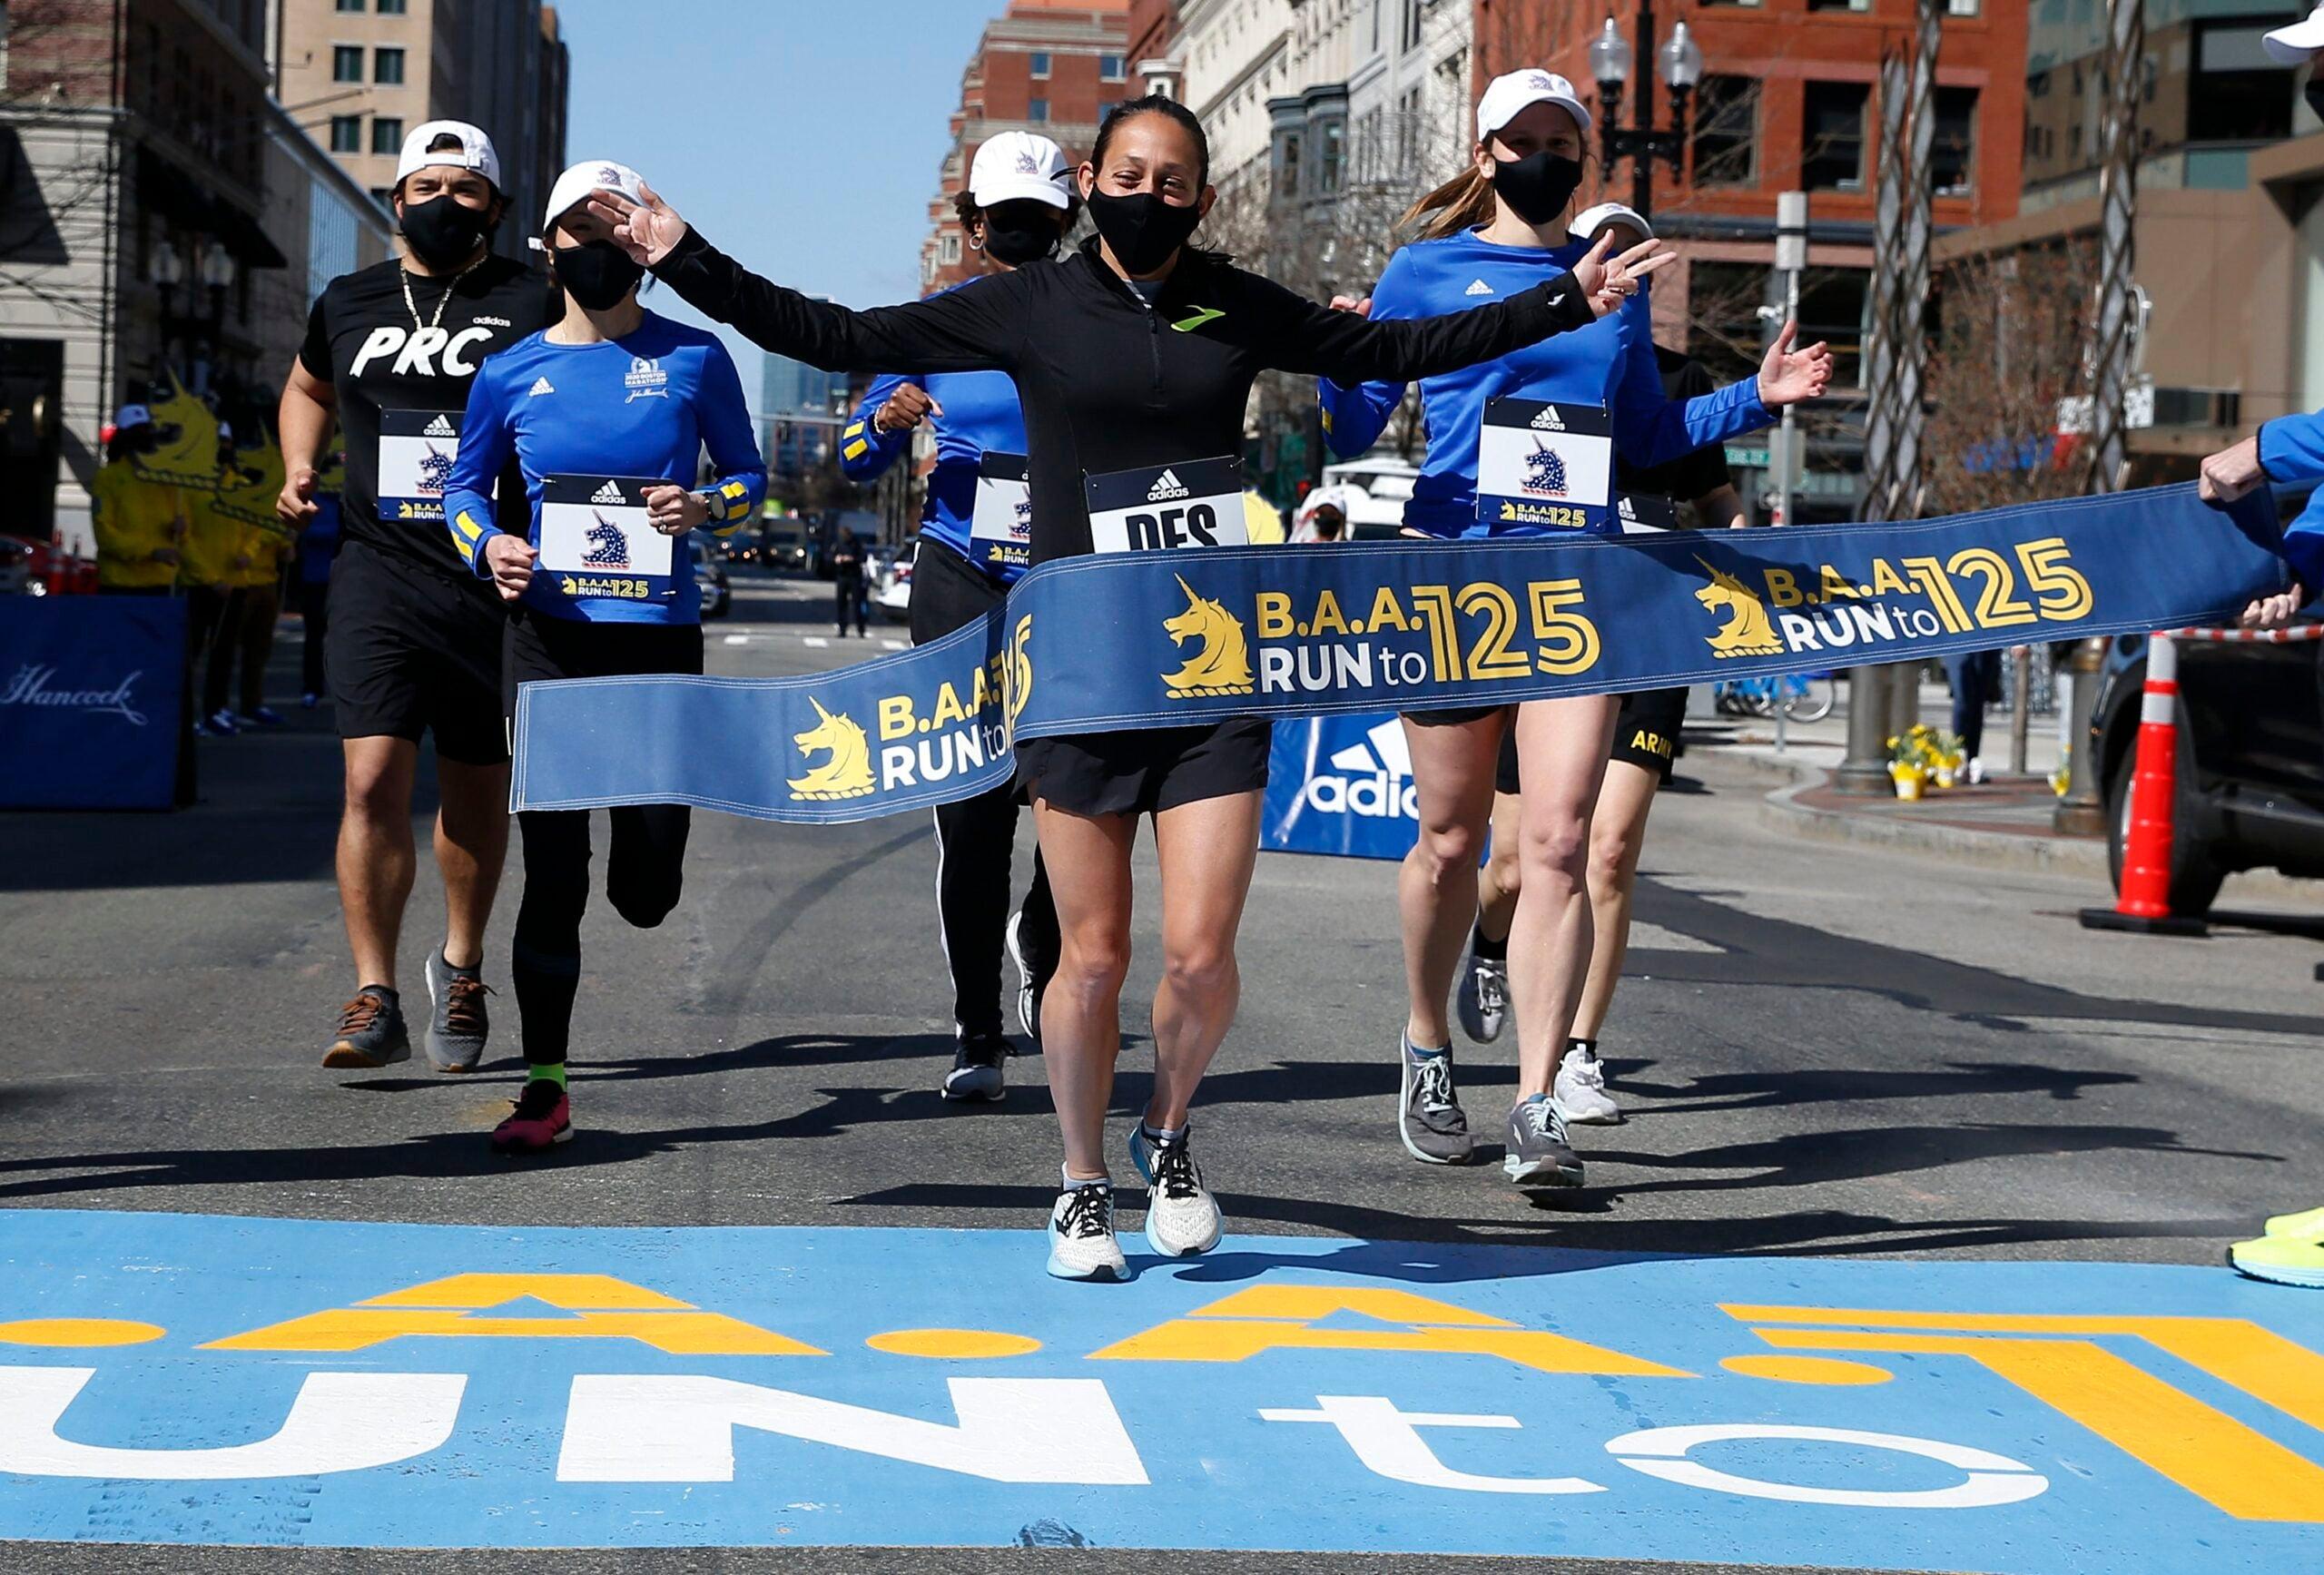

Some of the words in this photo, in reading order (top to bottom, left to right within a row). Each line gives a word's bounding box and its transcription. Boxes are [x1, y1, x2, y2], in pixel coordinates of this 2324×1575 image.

[473, 317, 511, 327] adidas
[349, 327, 494, 378] PRC
[423, 427, 456, 436] adidas
[1530, 418, 1565, 431] adidas
[414, 503, 443, 511] B.A.A
[590, 495, 626, 505] adidas
[1147, 486, 1189, 502] adidas
[414, 511, 435, 519] RUN
[1516, 513, 1540, 524] RUN
[1548, 507, 1586, 527] 125
[1517, 503, 1551, 516] B.A.A.
[1003, 555, 1025, 565] RUN
[578, 577, 612, 587] B.A.A.
[578, 586, 601, 596] RUN
[610, 579, 649, 598] 125
[1762, 557, 1923, 608] B.A.A.
[1900, 536, 2094, 635] 125
[1256, 586, 1423, 640] B.A.A.
[1893, 607, 1941, 639] to
[1259, 641, 1374, 694] RUN
[1378, 645, 1428, 686] to
[1410, 577, 1601, 683] 125
[1777, 602, 1896, 653] RUN
[0, 664, 148, 725] Hancock
[878, 666, 1000, 742] B.A.A.
[881, 724, 984, 792] RUN
[982, 723, 1007, 762] to
[1307, 770, 1419, 820] adi
[1256, 1395, 2049, 1509] to
